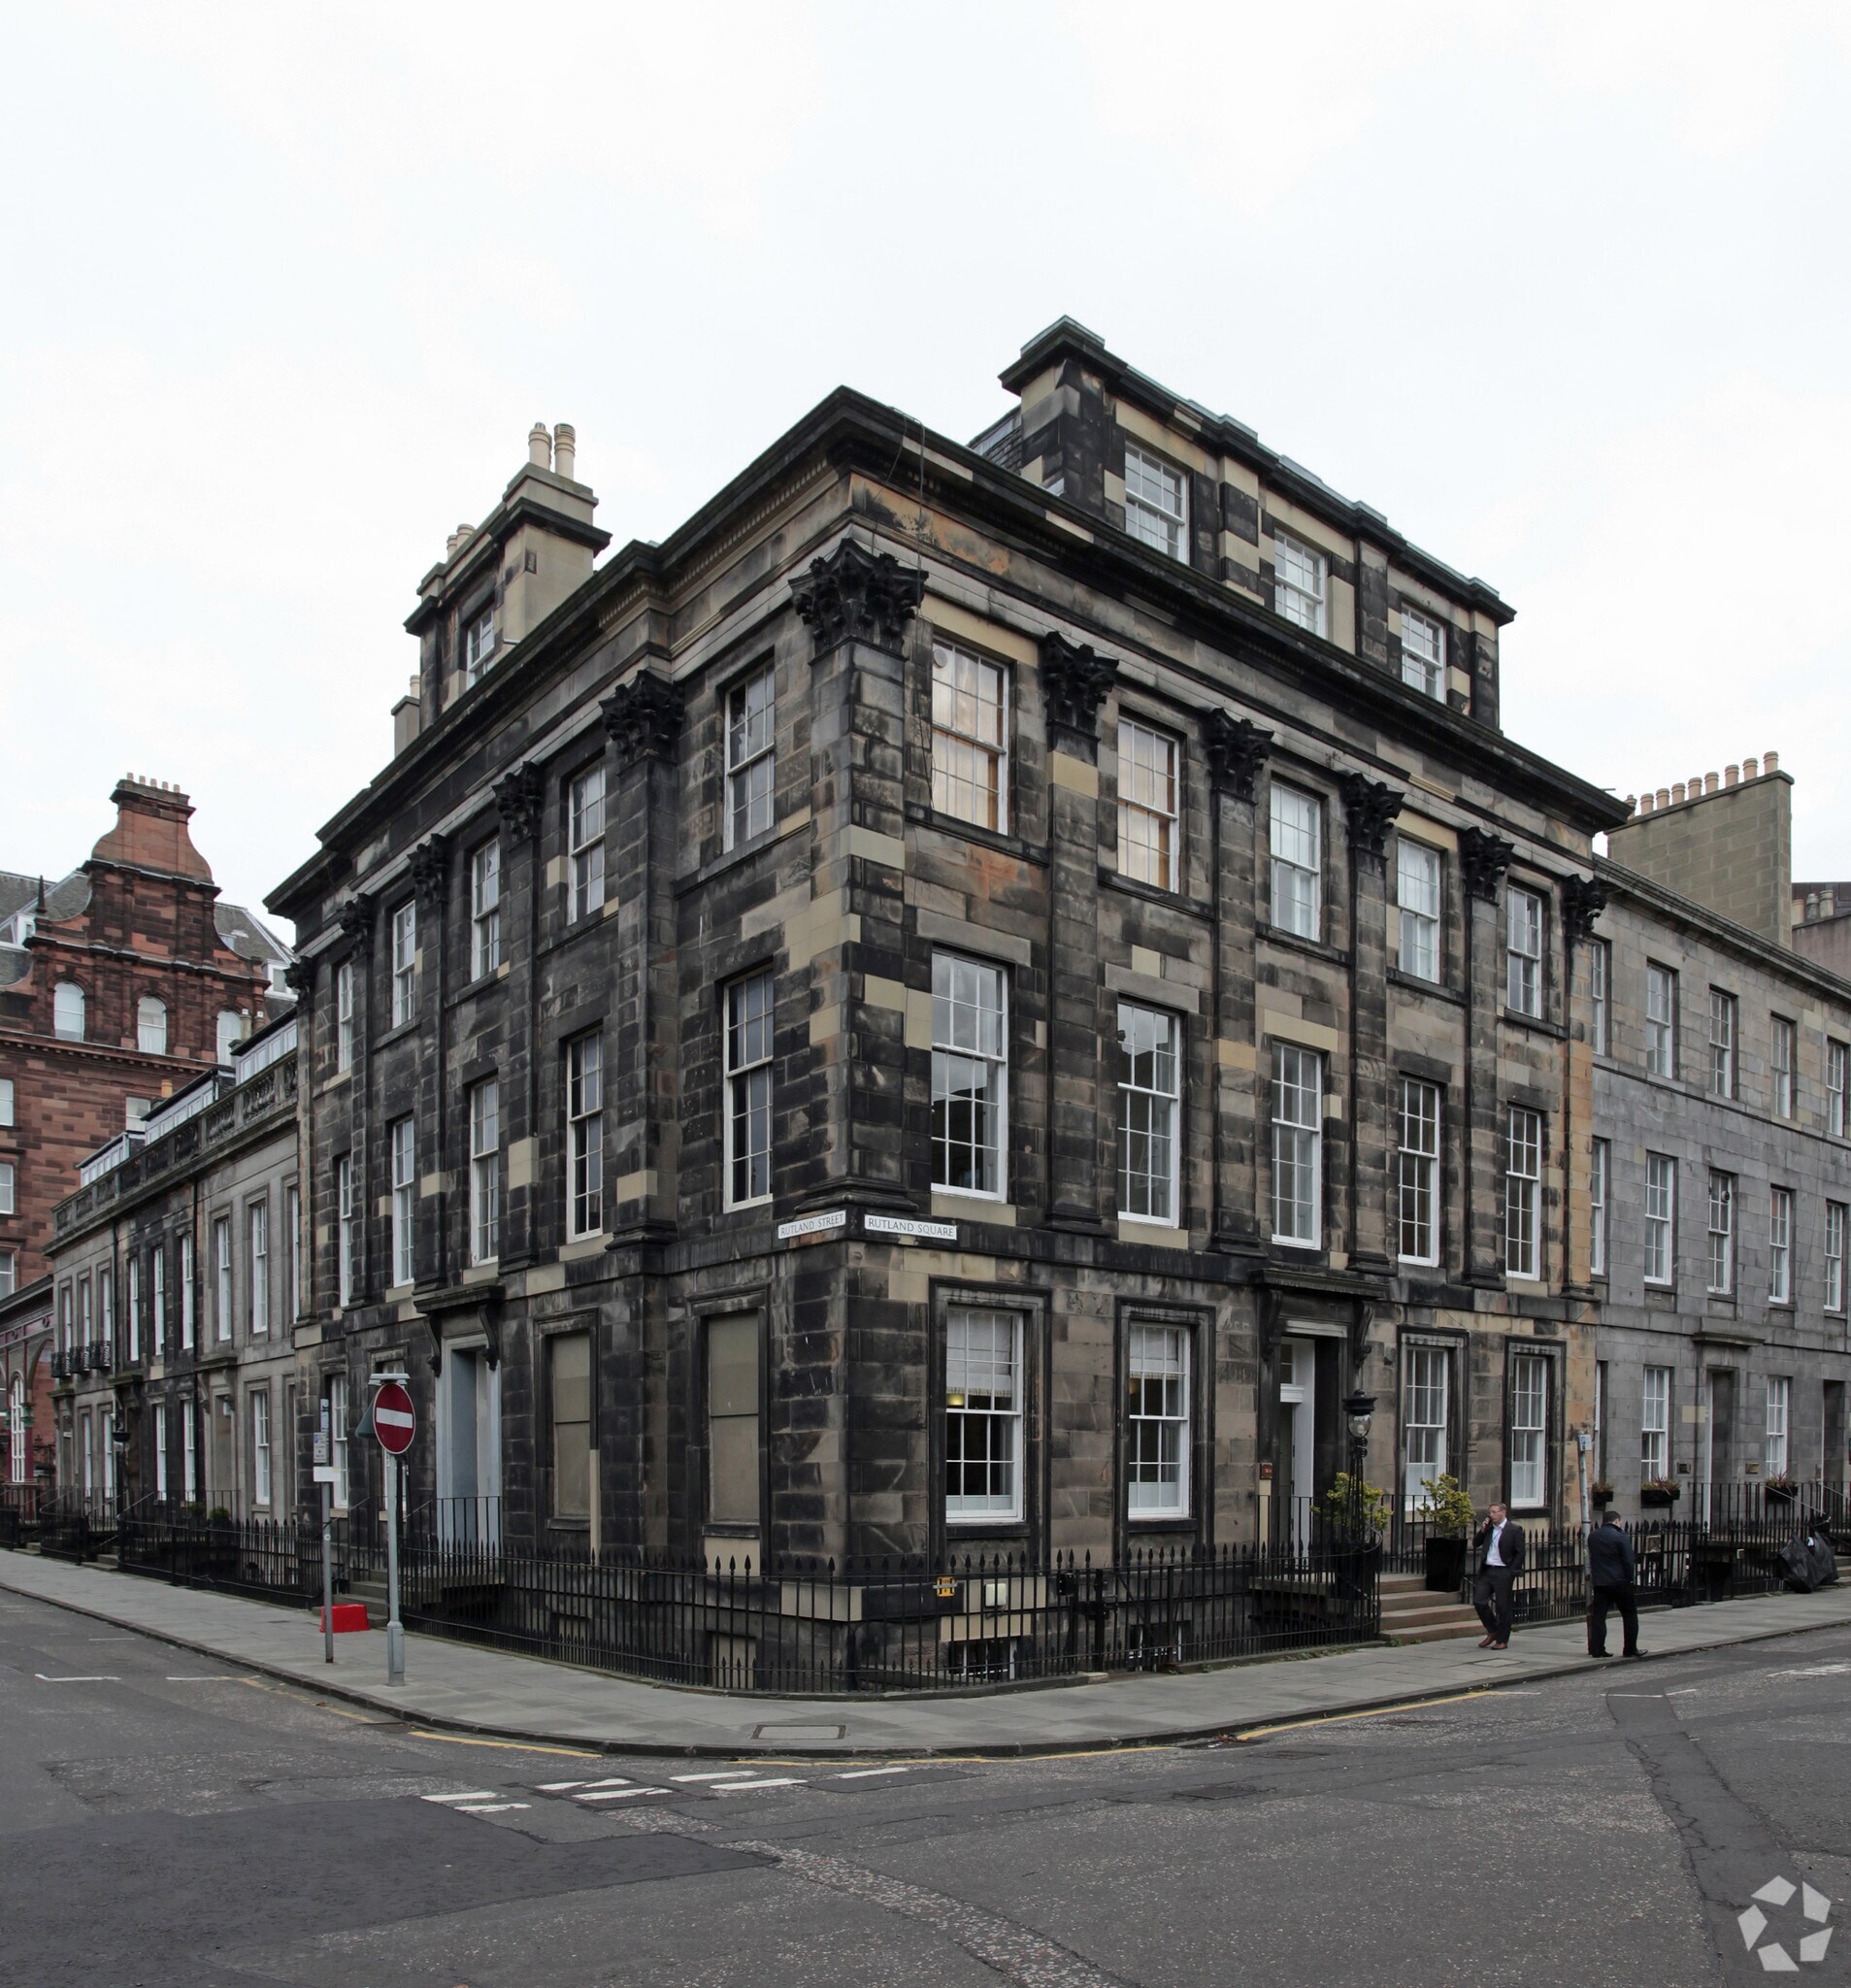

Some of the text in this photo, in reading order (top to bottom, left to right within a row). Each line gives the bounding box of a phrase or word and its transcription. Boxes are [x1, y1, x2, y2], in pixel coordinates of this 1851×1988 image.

[780, 1213, 843, 1236] RUTLAND STREET
[868, 1217, 954, 1238] RUTLAND SQUARE
